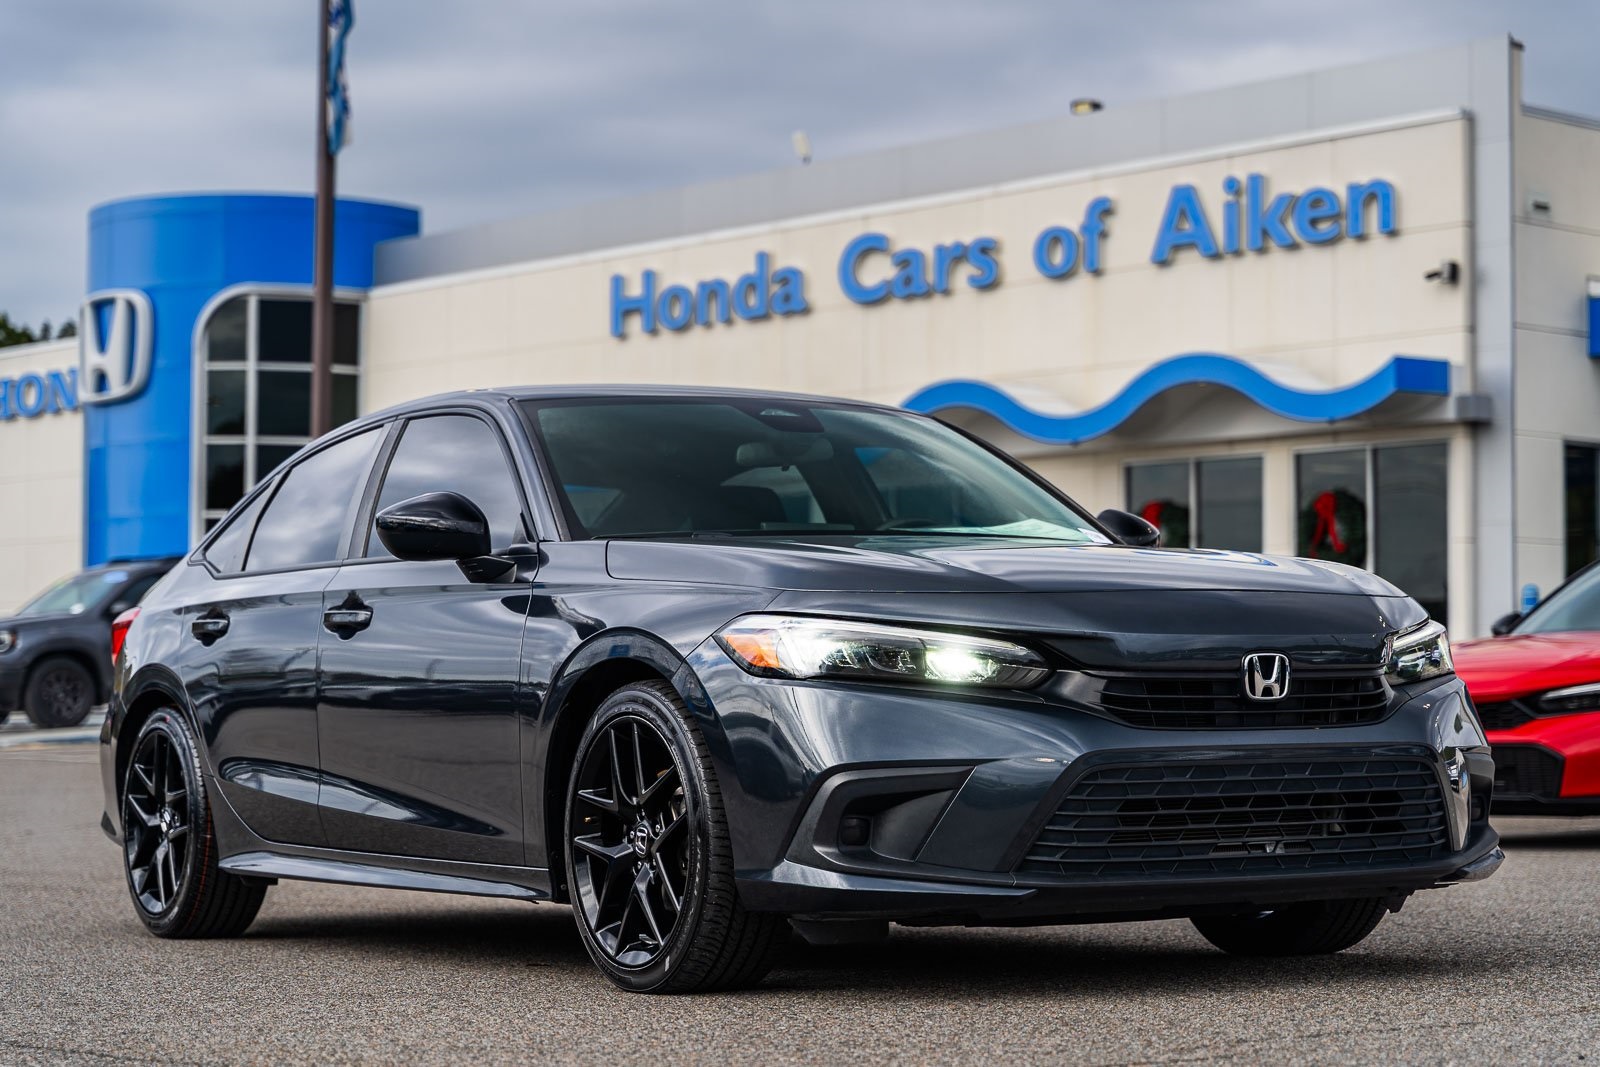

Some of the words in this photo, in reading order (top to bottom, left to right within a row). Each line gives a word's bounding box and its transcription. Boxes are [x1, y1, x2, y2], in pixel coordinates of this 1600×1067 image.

[611, 251, 807, 338] Honda
[838, 232, 998, 305] Cars
[1033, 196, 1113, 279] of
[1151, 173, 1396, 264] Aiken
